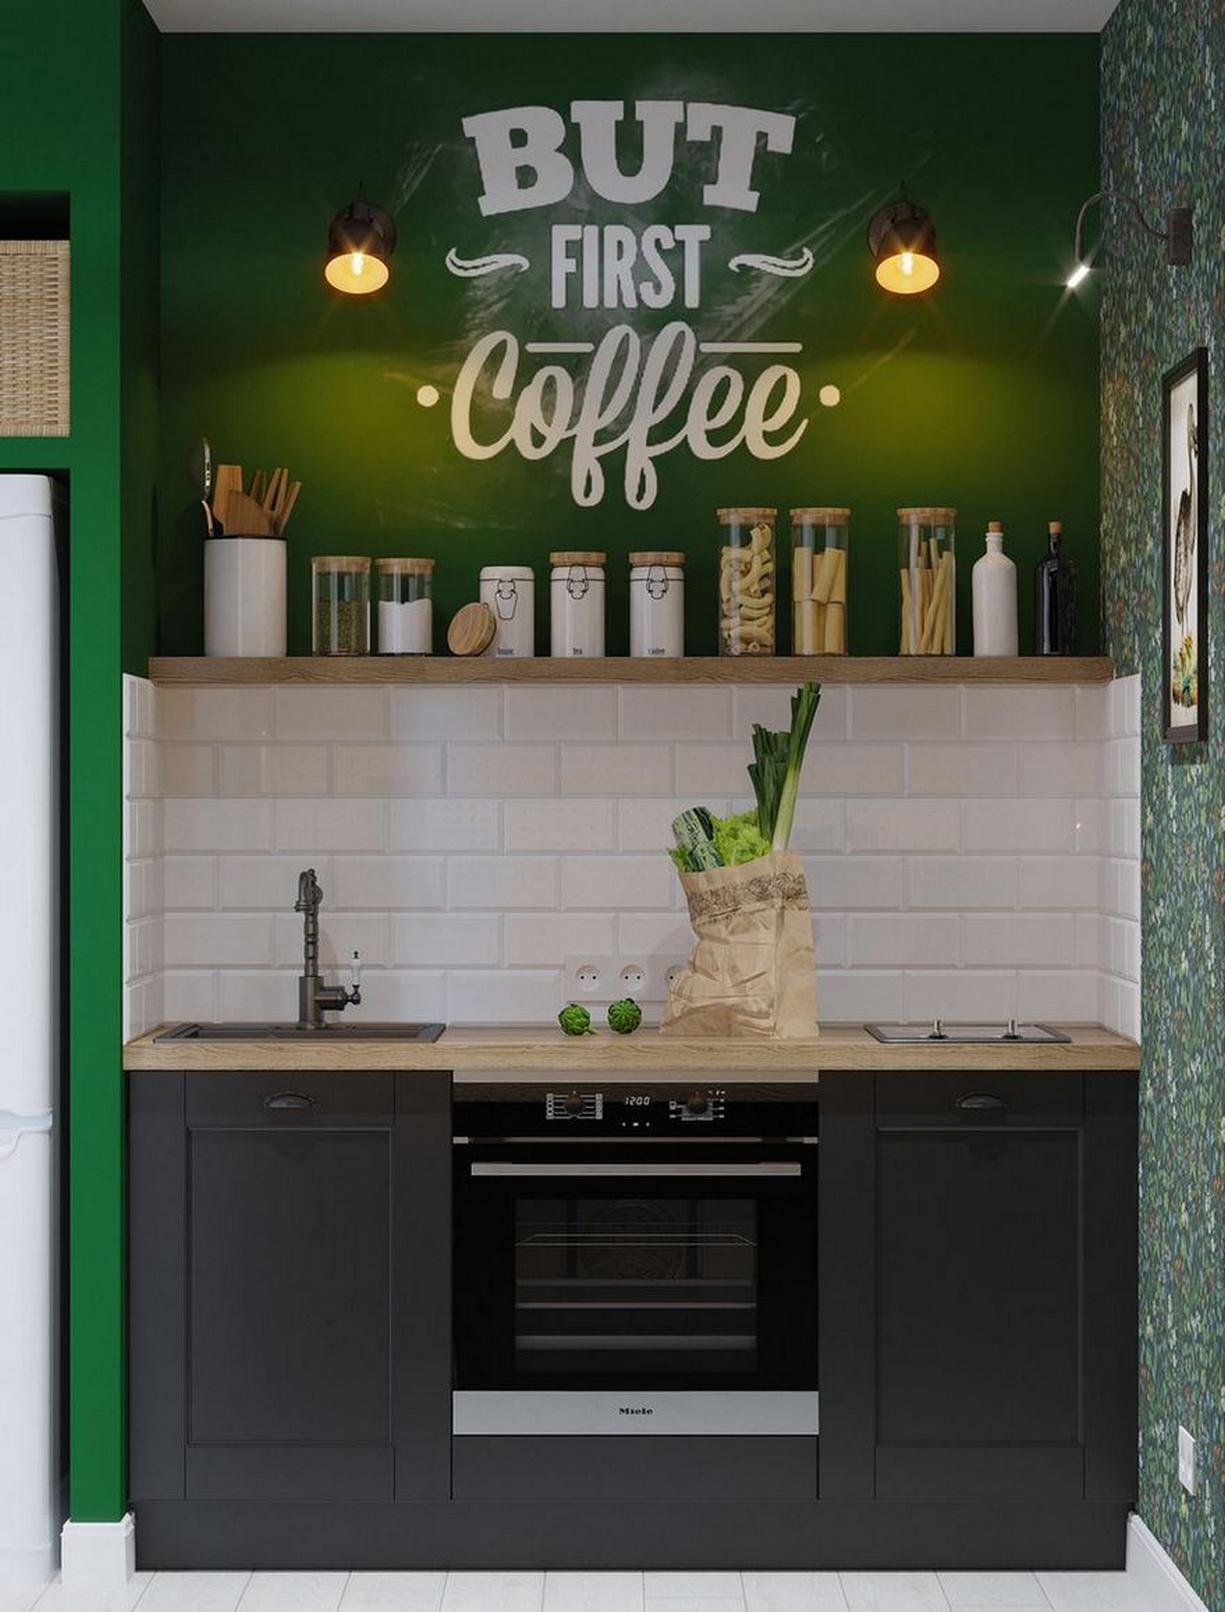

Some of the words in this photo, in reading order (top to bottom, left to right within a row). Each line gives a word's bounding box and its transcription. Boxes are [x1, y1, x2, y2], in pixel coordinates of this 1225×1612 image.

[461, 100, 797, 217] BUT
[550, 224, 712, 309] FIRST
[450, 321, 809, 511] Coffee
[618, 1407, 654, 1416] Miele
